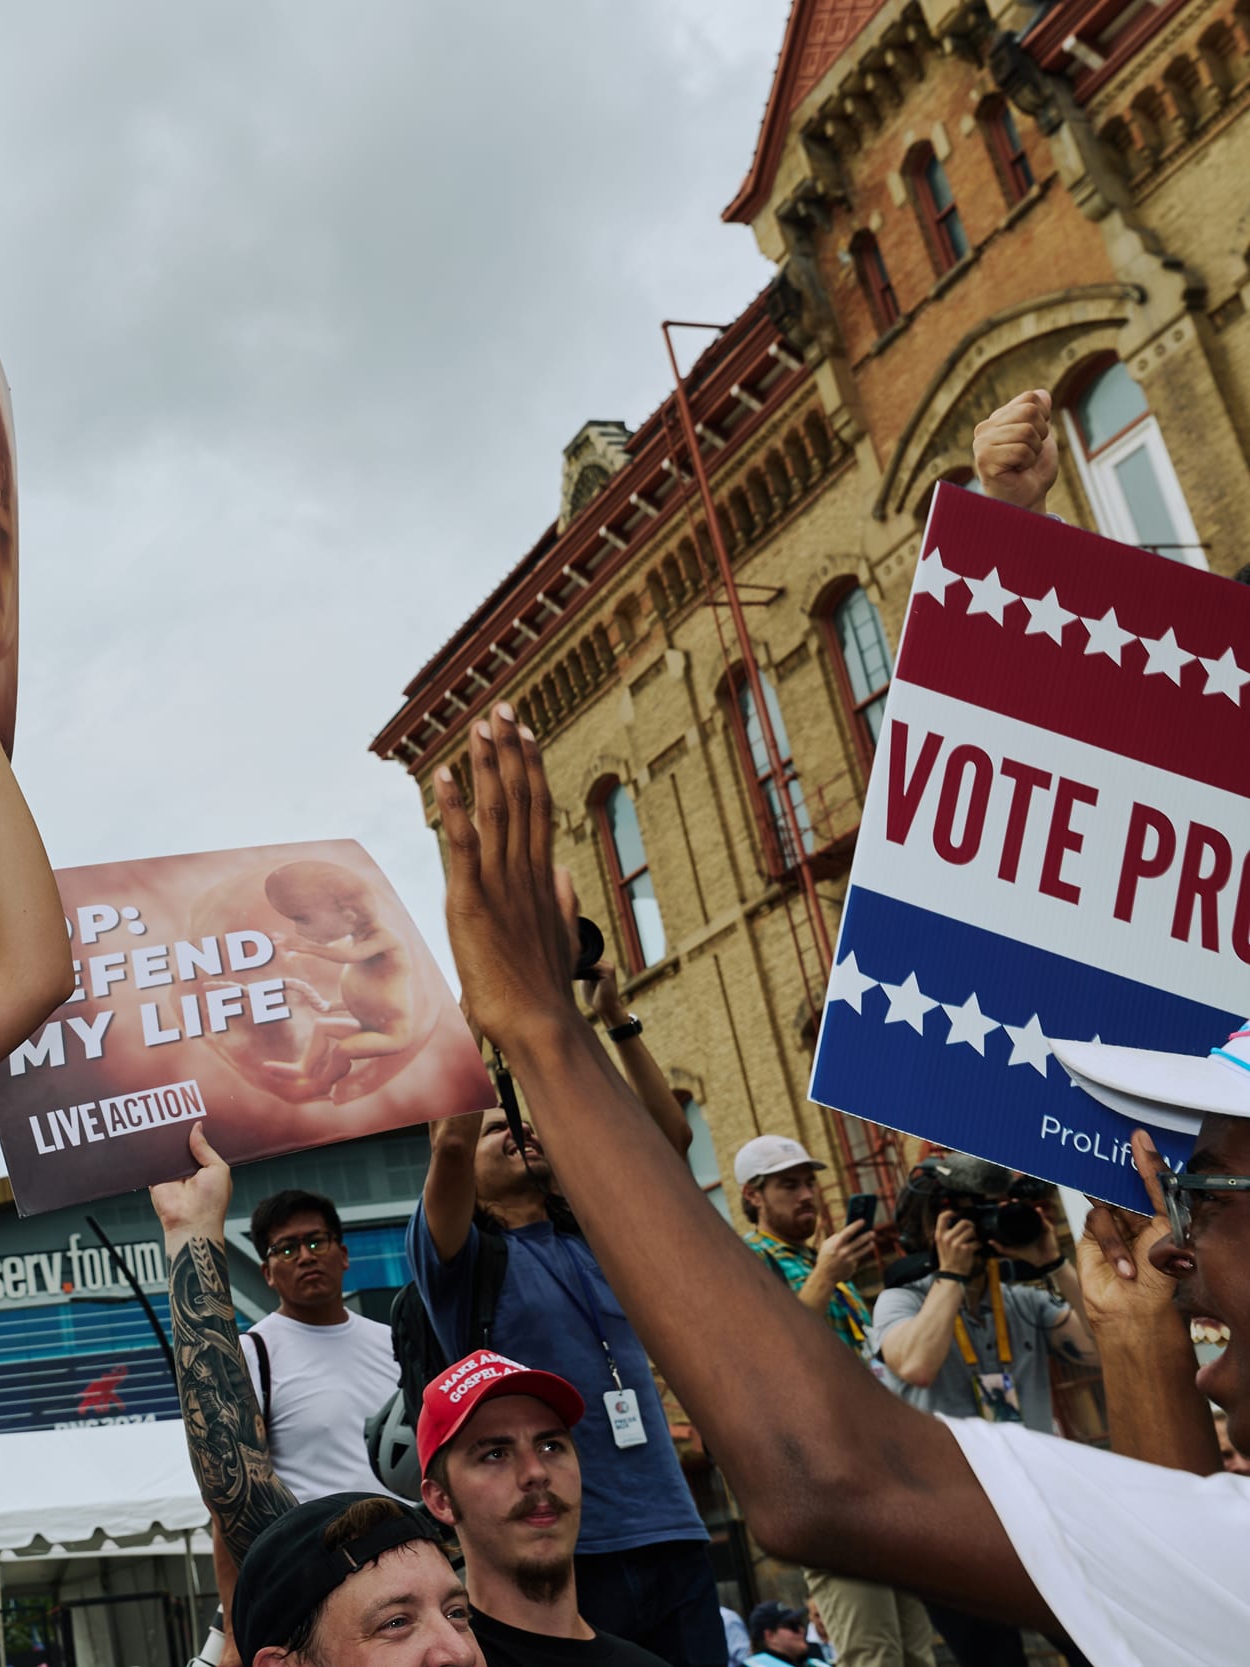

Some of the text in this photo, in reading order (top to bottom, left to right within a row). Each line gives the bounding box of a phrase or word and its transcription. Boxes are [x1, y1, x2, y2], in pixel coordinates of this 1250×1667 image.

[886, 719, 1099, 906] VOTE
[66, 930, 274, 1002] FEND
[9, 979, 291, 1077] MY LIFE
[29, 1084, 202, 1155] LIVE ACTION
[439, 1360, 478, 1393] MAKE
[449, 1367, 502, 1402] GOSPEL
